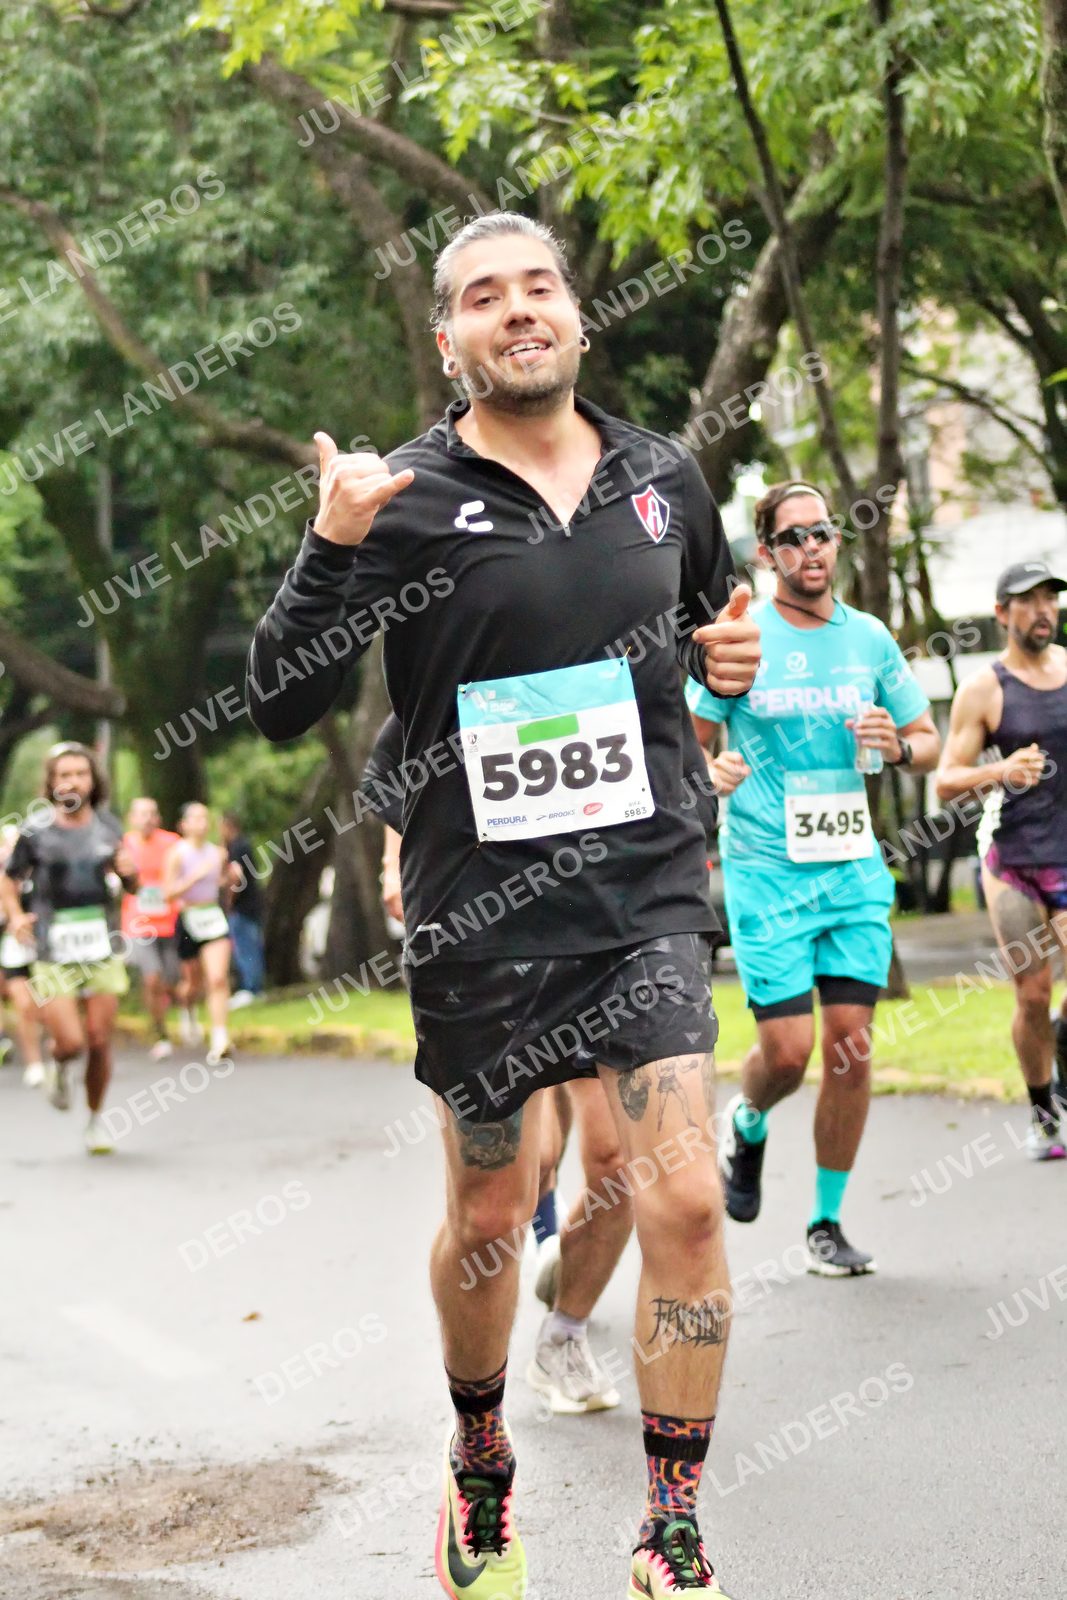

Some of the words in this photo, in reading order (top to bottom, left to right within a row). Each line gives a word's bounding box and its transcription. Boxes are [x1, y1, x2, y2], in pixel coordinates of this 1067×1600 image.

[748, 684, 860, 712] PERDUR
[480, 733, 633, 801] 5983
[487, 815, 528, 826] PERDURA
[548, 809, 576, 819] BROOKS
[624, 807, 648, 818] 5983
[795, 809, 864, 838] 3495
